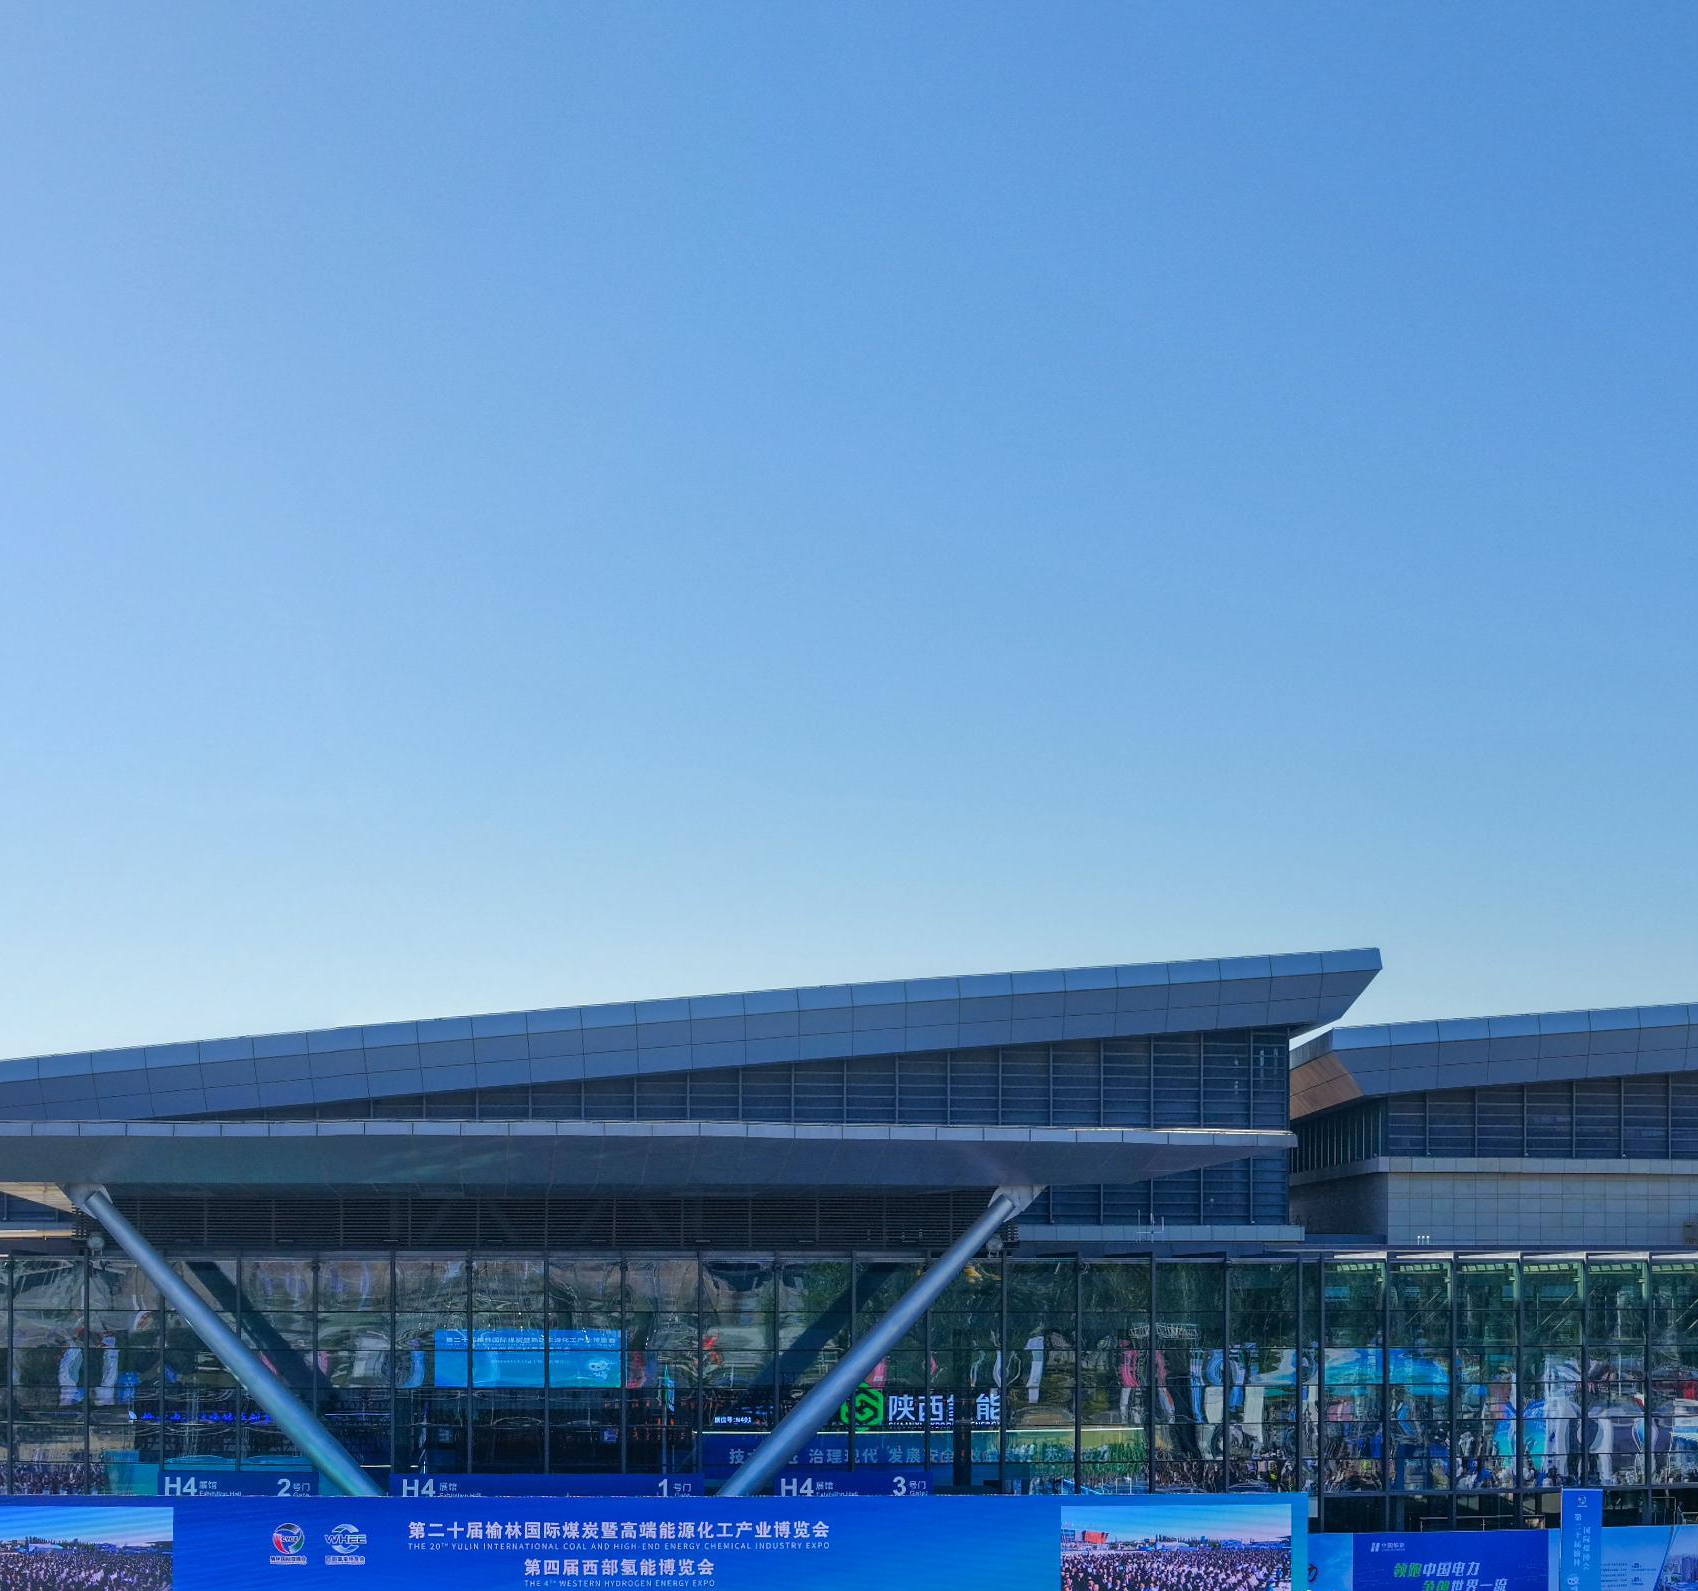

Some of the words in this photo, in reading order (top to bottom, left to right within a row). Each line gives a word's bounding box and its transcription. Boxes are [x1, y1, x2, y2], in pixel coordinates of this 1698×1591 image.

[164, 1476, 197, 1496] H4
[276, 1478, 291, 1496] 2
[402, 1478, 437, 1496] H4
[657, 1478, 670, 1496] 1
[780, 1477, 814, 1496] H4
[892, 1476, 906, 1496] 3
[325, 1533, 367, 1546] WHEE
[407, 1520, 831, 1541] 第二十届榆林国际煤炭暨高端能源化工产业博览会
[408, 1541, 427, 1550] THE
[452, 1541, 480, 1550] YULIN
[483, 1541, 559, 1550] INTERNATIONAL
[563, 1541, 588, 1550] COAL
[591, 1541, 611, 1550] AND
[614, 1541, 662, 1550] HIGH-END
[664, 1541, 701, 1550] ENERGY
[704, 1541, 752, 1550] CHEMICAL
[755, 1541, 804, 1550] INDUSTRY
[806, 1541, 830, 1550] EXPO
[524, 1558, 715, 1577] 第四届西部氢能博览会
[1393, 1561, 1481, 1579] 领跑中国电力
[524, 1579, 541, 1588] THE
[558, 1579, 602, 1588] WESTERN
[604, 1579, 653, 1588] HYDROGEN
[656, 1579, 689, 1588] ENERGY
[692, 1579, 716, 1588] EXPO
